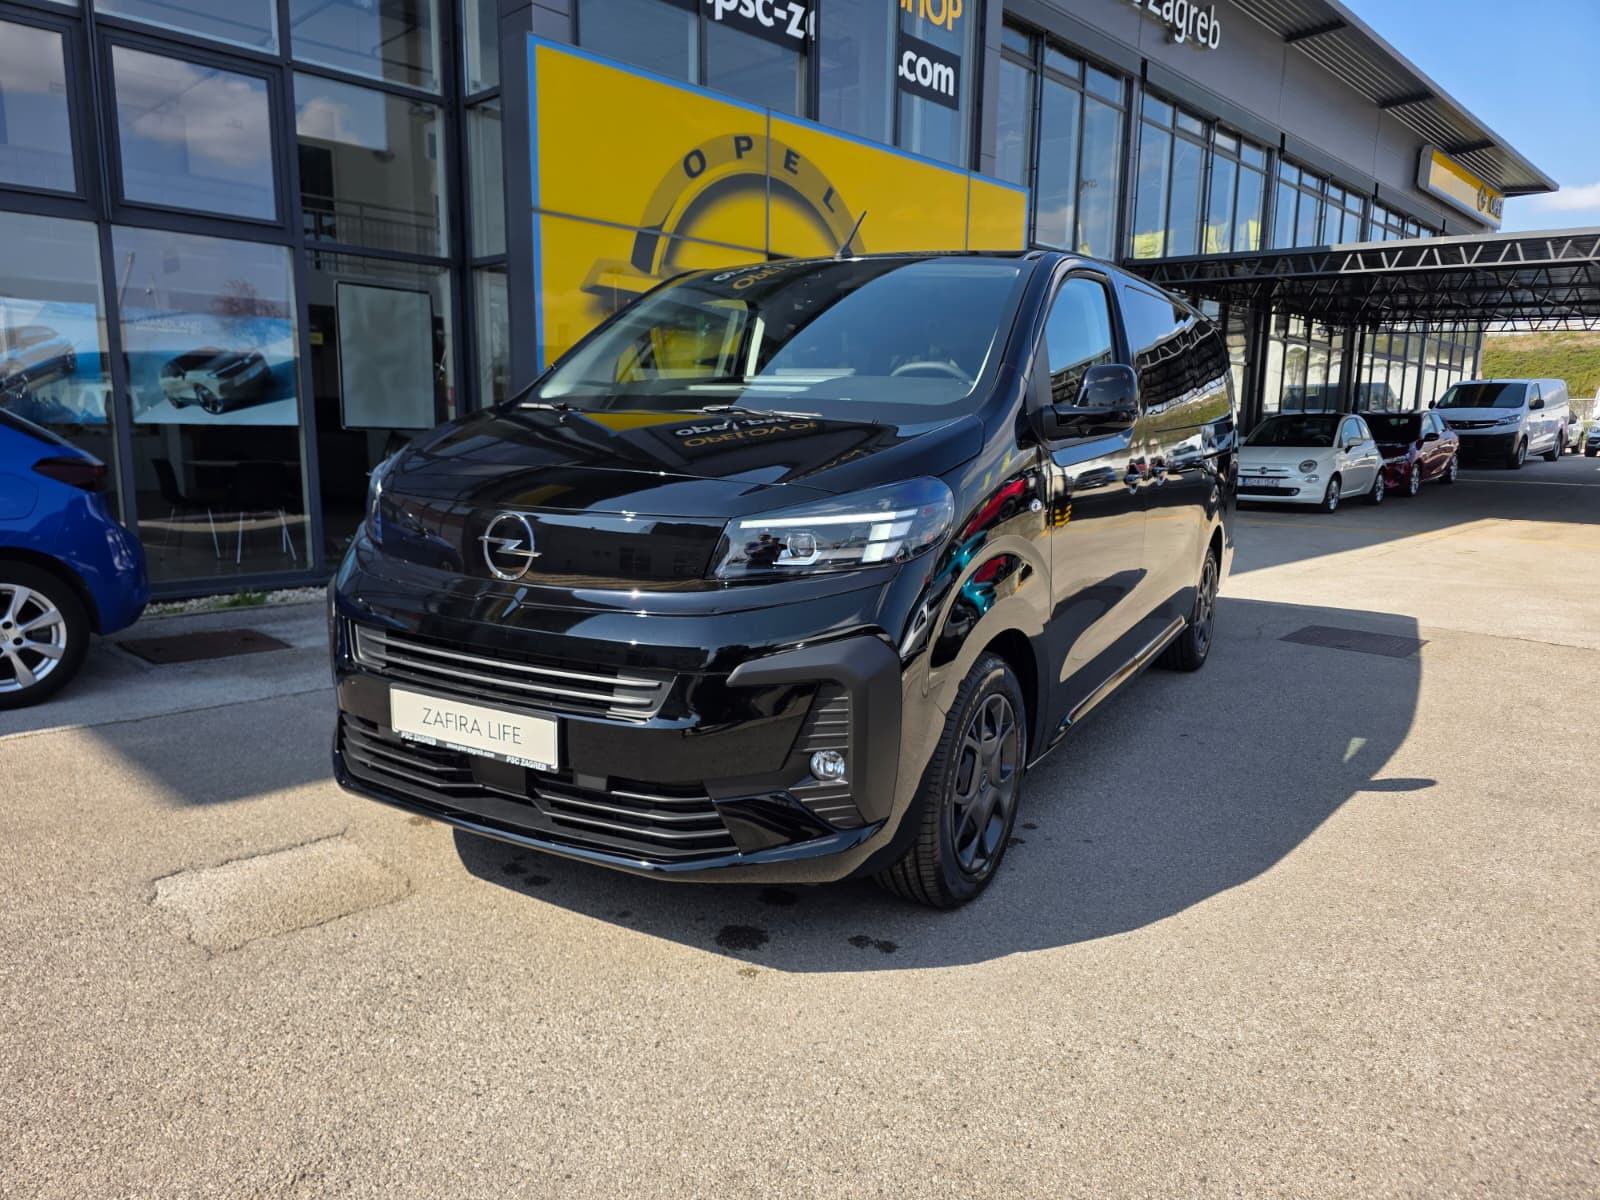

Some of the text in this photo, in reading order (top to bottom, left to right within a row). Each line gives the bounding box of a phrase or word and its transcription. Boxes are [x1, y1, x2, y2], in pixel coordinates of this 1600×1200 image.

[898, 50, 955, 97] .com
[683, 135, 836, 214] OPEL
[422, 707, 522, 745] ZAFIRA LIFE
[506, 755, 520, 765] PSC
